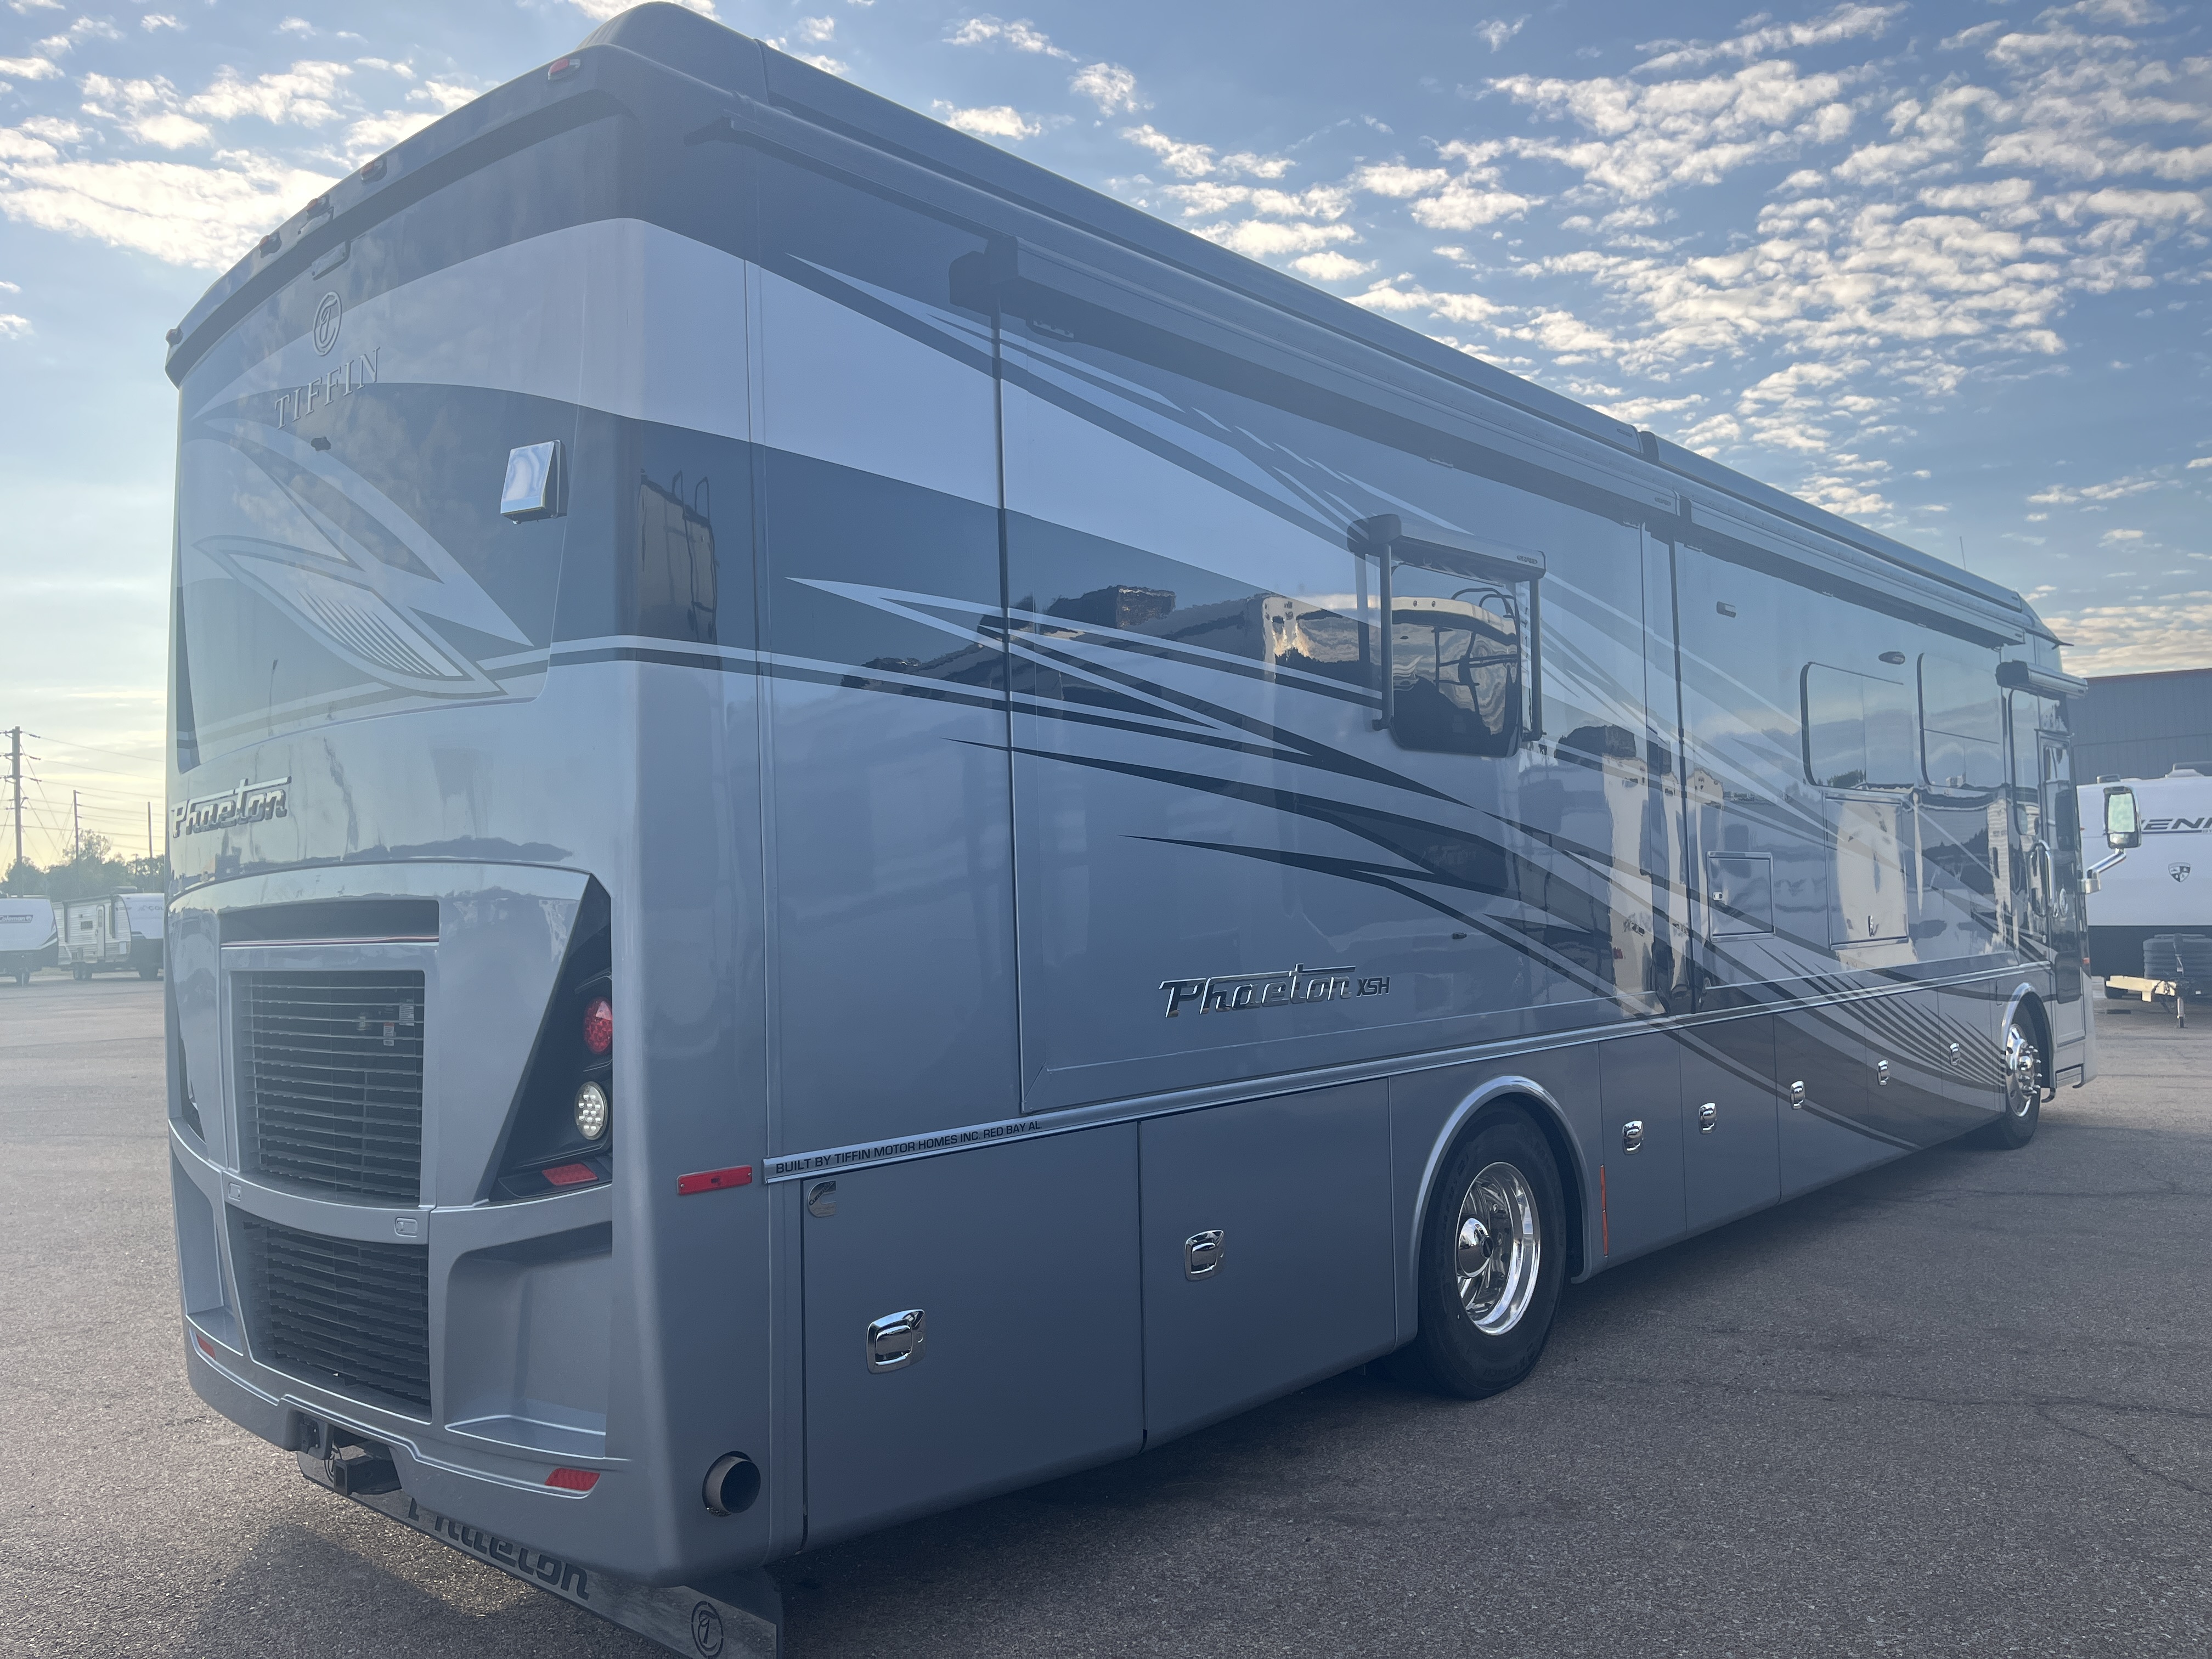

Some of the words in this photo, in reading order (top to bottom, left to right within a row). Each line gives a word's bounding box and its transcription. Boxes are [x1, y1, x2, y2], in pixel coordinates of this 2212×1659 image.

[275, 347, 380, 429] TIFFIN
[171, 776, 292, 838] Phaeton
[1159, 963, 1356, 1018] Phaeton
[1356, 976, 1391, 997] XSH
[776, 1158, 811, 1173] BUILT
[815, 1156, 831, 1167] BY
[834, 1149, 871, 1164] TIFFIN
[874, 1142, 915, 1157] MOTOR
[918, 1135, 957, 1150] HOMES
[984, 1127, 1003, 1138] RED
[1006, 1123, 1026, 1135] BAY
